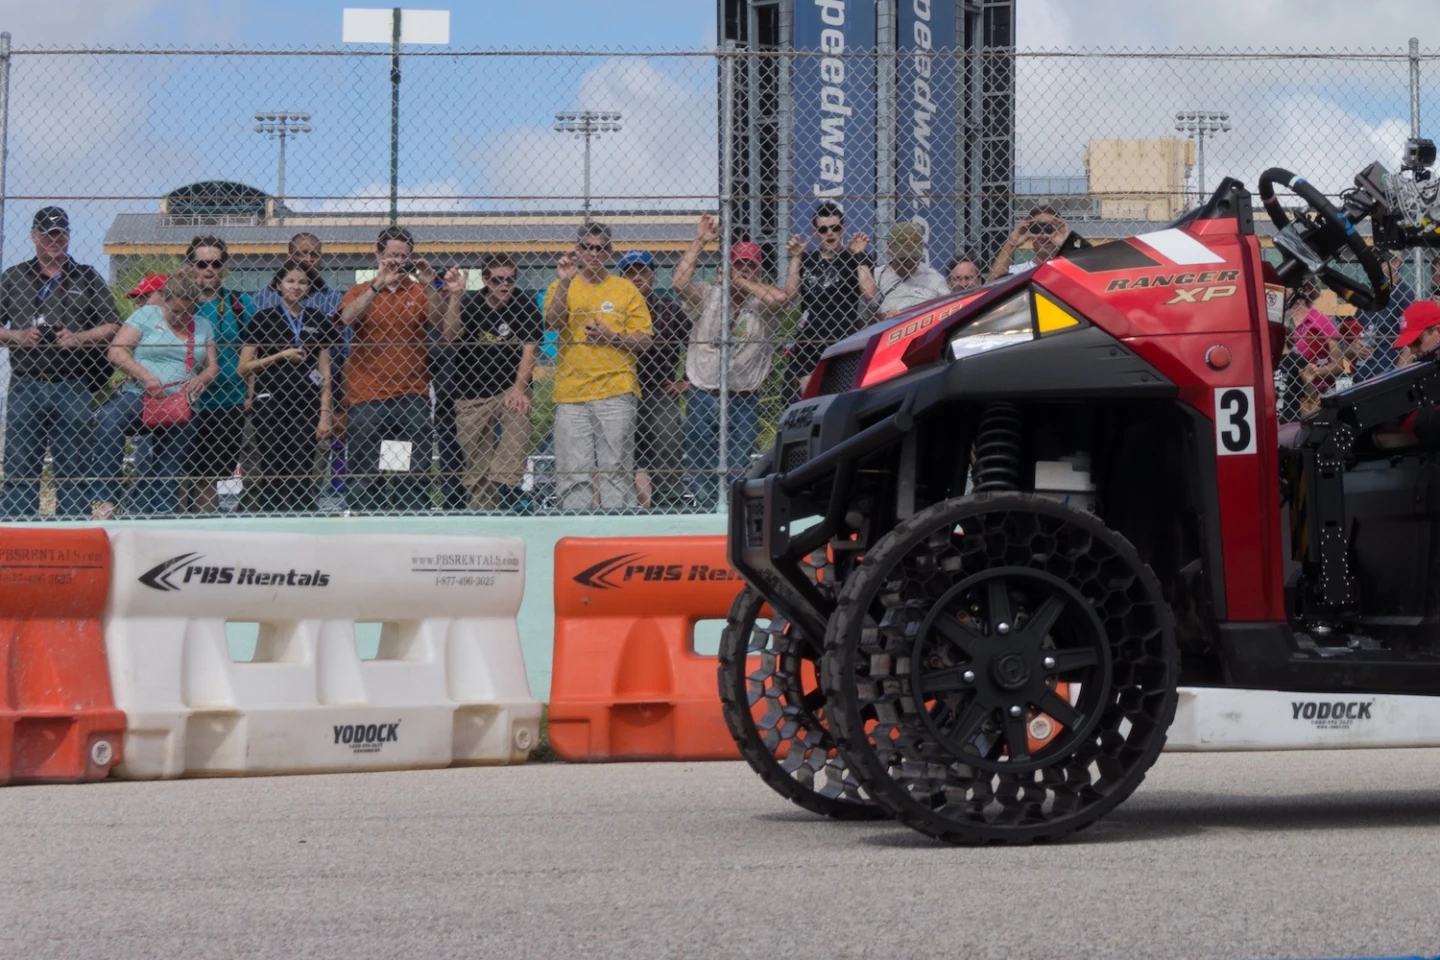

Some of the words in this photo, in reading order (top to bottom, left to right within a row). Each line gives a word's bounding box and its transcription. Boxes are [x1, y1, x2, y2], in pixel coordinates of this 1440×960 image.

[1105, 269, 1240, 293] RANGER
[1161, 284, 1238, 306] XP
[887, 312, 936, 346] 900
[1220, 388, 1251, 452] 3
[411, 554, 520, 567] www.PBSRENTALS.com
[183, 565, 235, 585] PBS
[236, 567, 331, 587] Rentals
[435, 576, 495, 586] 1-877-496-3625
[622, 564, 685, 582] PBS
[1291, 701, 1374, 720] YODOCK
[332, 723, 400, 745] YODOCK
